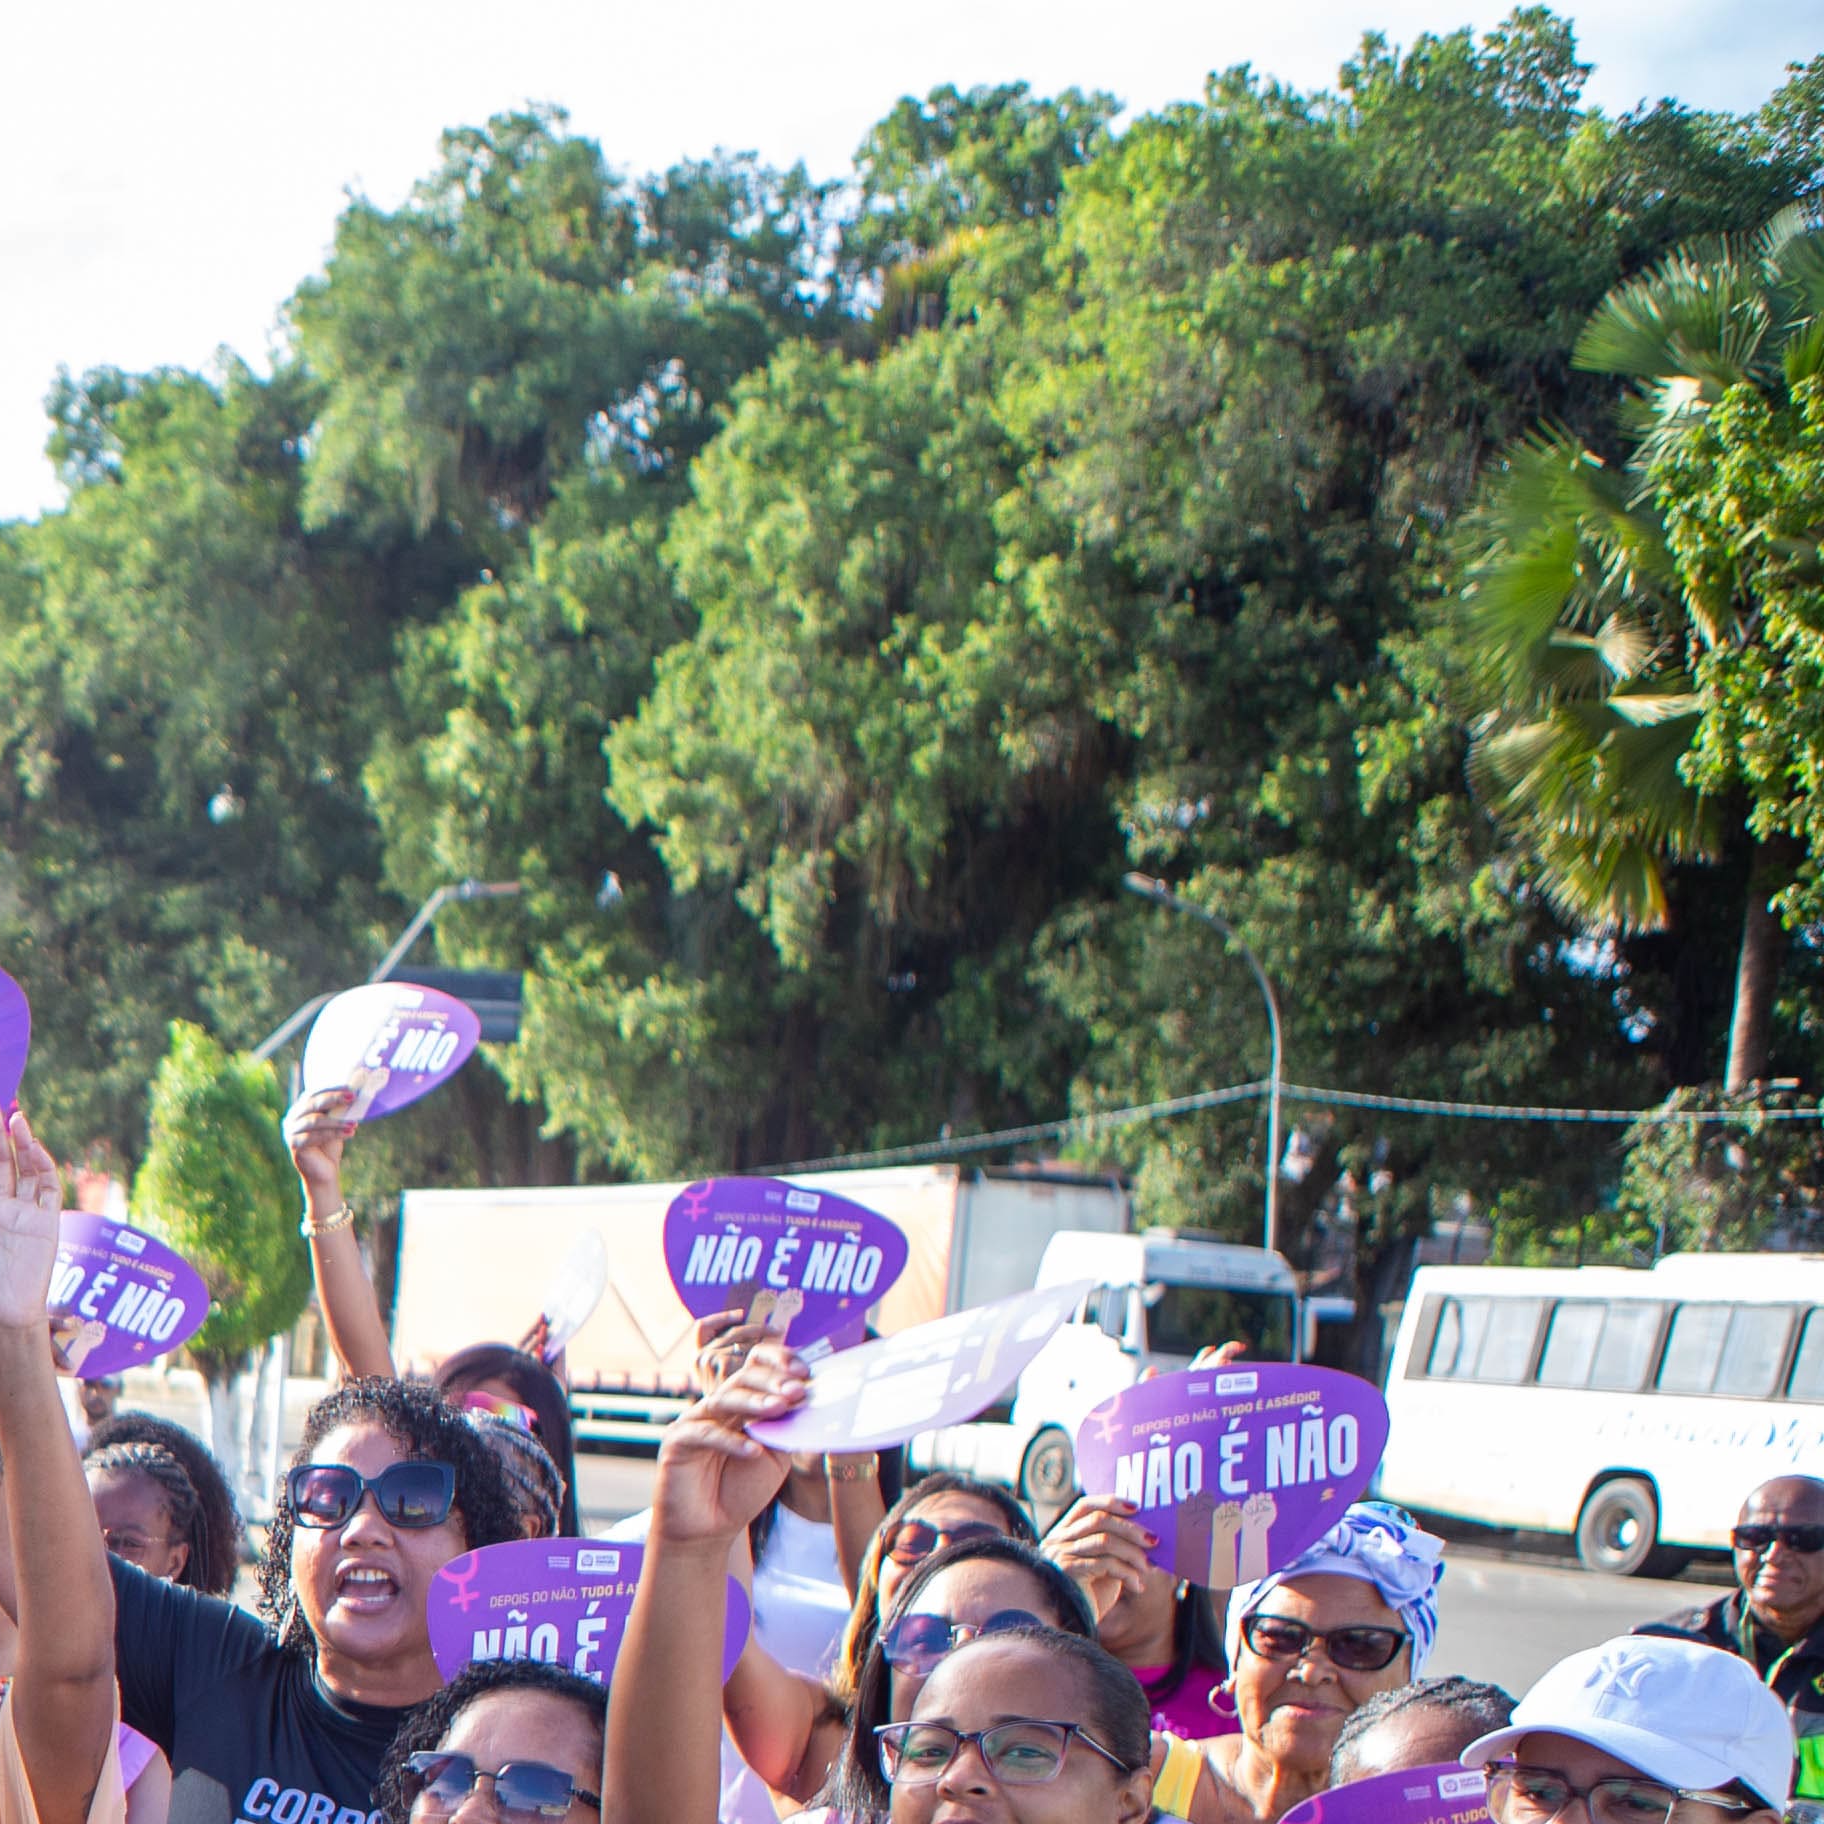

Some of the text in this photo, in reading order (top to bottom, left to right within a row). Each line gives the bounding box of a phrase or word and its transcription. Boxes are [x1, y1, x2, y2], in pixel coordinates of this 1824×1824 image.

[364, 1017, 459, 1073] É NÃO
[683, 1223, 884, 1297] NÃO É NÃO
[79, 1263, 185, 1342] É NÃO
[1132, 1389, 1321, 1437] DEPOIS DO TUDO É ASSÉDIO!
[1114, 1404, 1359, 1513] NÃO É NÃO
[490, 1580, 625, 1609] DEPOIS DO NÃO, TUDO É
[574, 1601, 607, 1685] É
